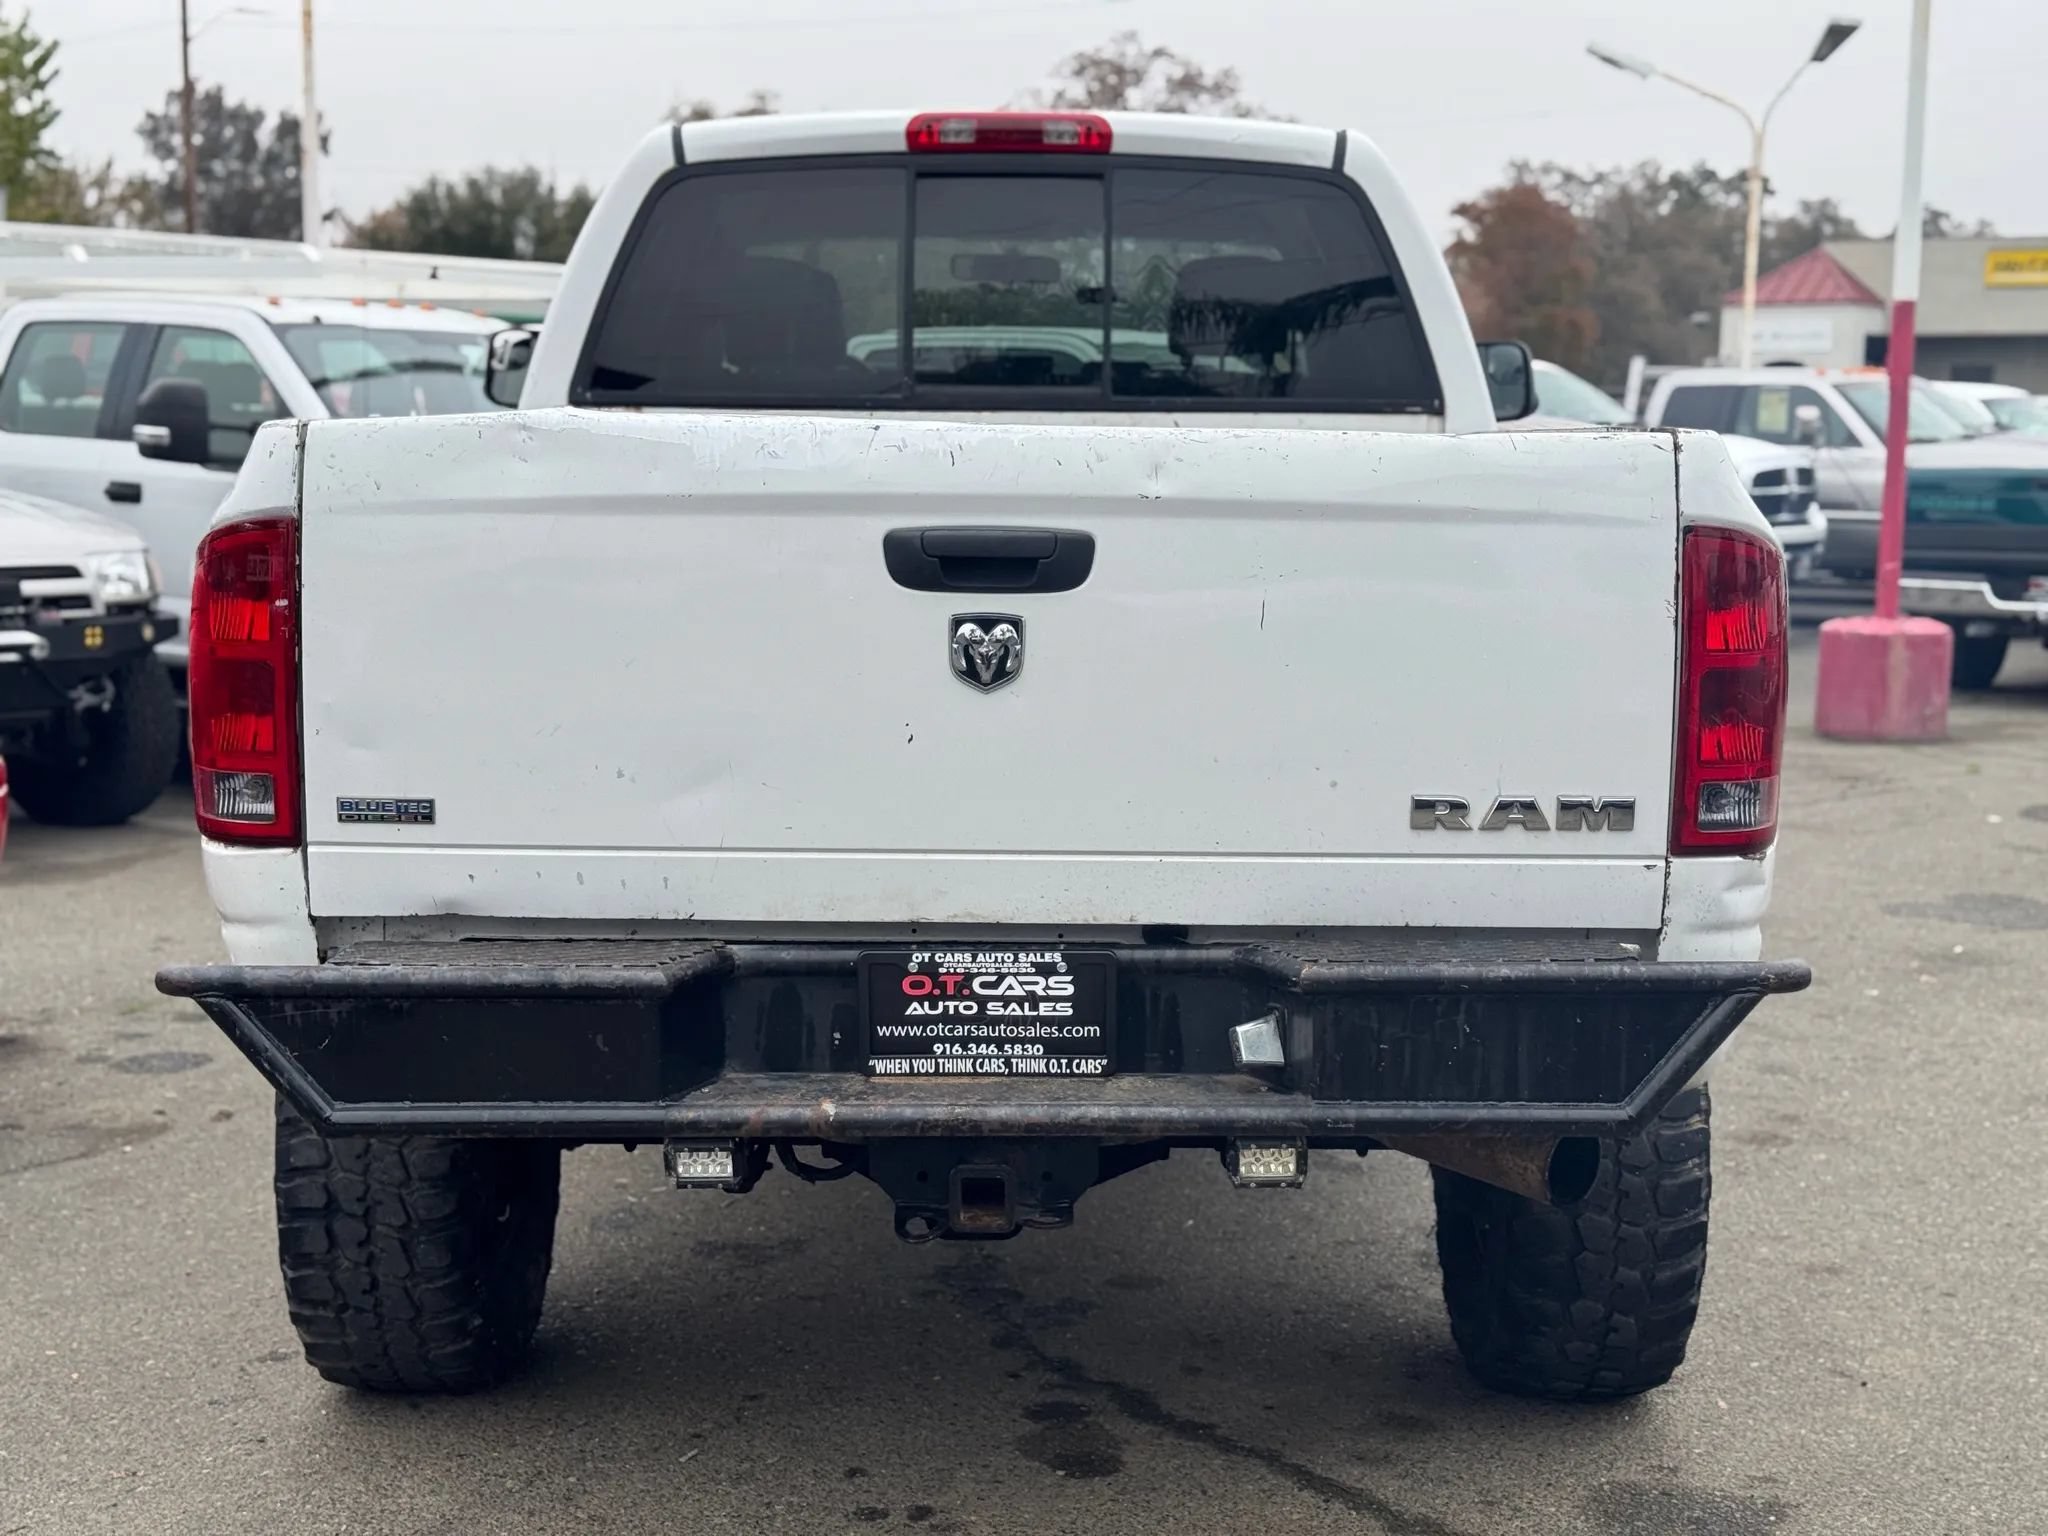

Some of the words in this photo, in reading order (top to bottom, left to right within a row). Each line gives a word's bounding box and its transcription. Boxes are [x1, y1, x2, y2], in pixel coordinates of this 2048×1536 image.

[339, 799, 431, 813] BLUETEC
[1410, 795, 1636, 832] RAM
[912, 953, 931, 963] OT
[935, 953, 973, 963] CARS
[976, 953, 1014, 963] AUTO
[1018, 953, 1062, 963] SALES
[904, 1001, 978, 1016] AUTO
[985, 1001, 1074, 1016] SALES
[876, 1022, 1100, 1038] www.otcarsautosales.com
[933, 1043, 1044, 1056] 916.346.5830
[912, 1058, 936, 1074] YOU
[938, 1058, 974, 1074] THINK
[976, 1058, 1009, 1075] CARS,
[1011, 1058, 1047, 1074] THINK
[1049, 1059, 1070, 1074] O.T.
